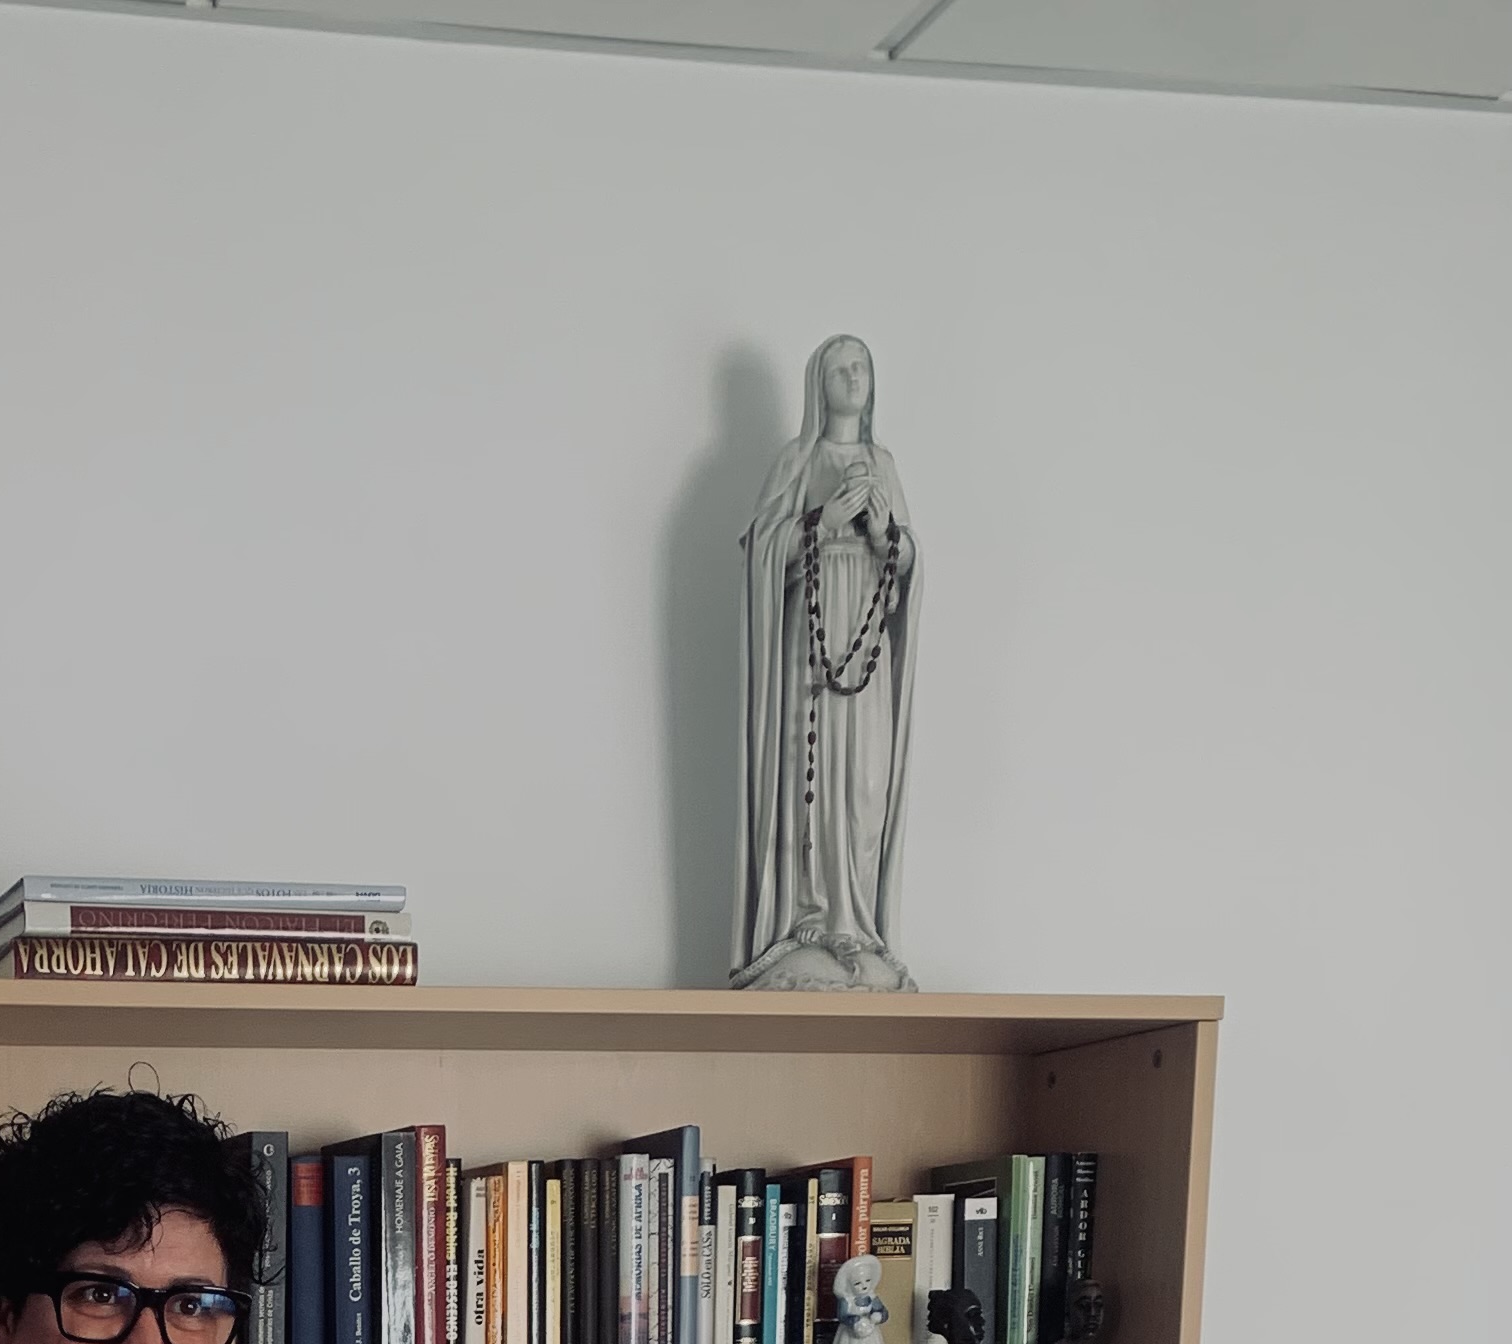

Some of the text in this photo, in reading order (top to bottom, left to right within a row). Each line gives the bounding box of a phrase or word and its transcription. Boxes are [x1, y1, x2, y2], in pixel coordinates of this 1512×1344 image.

[21, 939, 414, 980] LOS CARNAVALES DE CALAHORRA
[395, 1142, 404, 1234] HOMENAJE A GAIA
[426, 1178, 437, 1202] LISA
[858, 1168, 870, 1223] púrpura
[1051, 1178, 1059, 1215] AURORA
[348, 1166, 363, 1302] Caballo de Troya, 3
[634, 1226, 642, 1239] DE
[768, 1198, 777, 1251] BRADBURY
[872, 1237, 911, 1246] SAGRADA
[446, 1264, 458, 1279] EL
[474, 1249, 485, 1326] otra vida
[446, 1280, 458, 1341] DESCENSO
